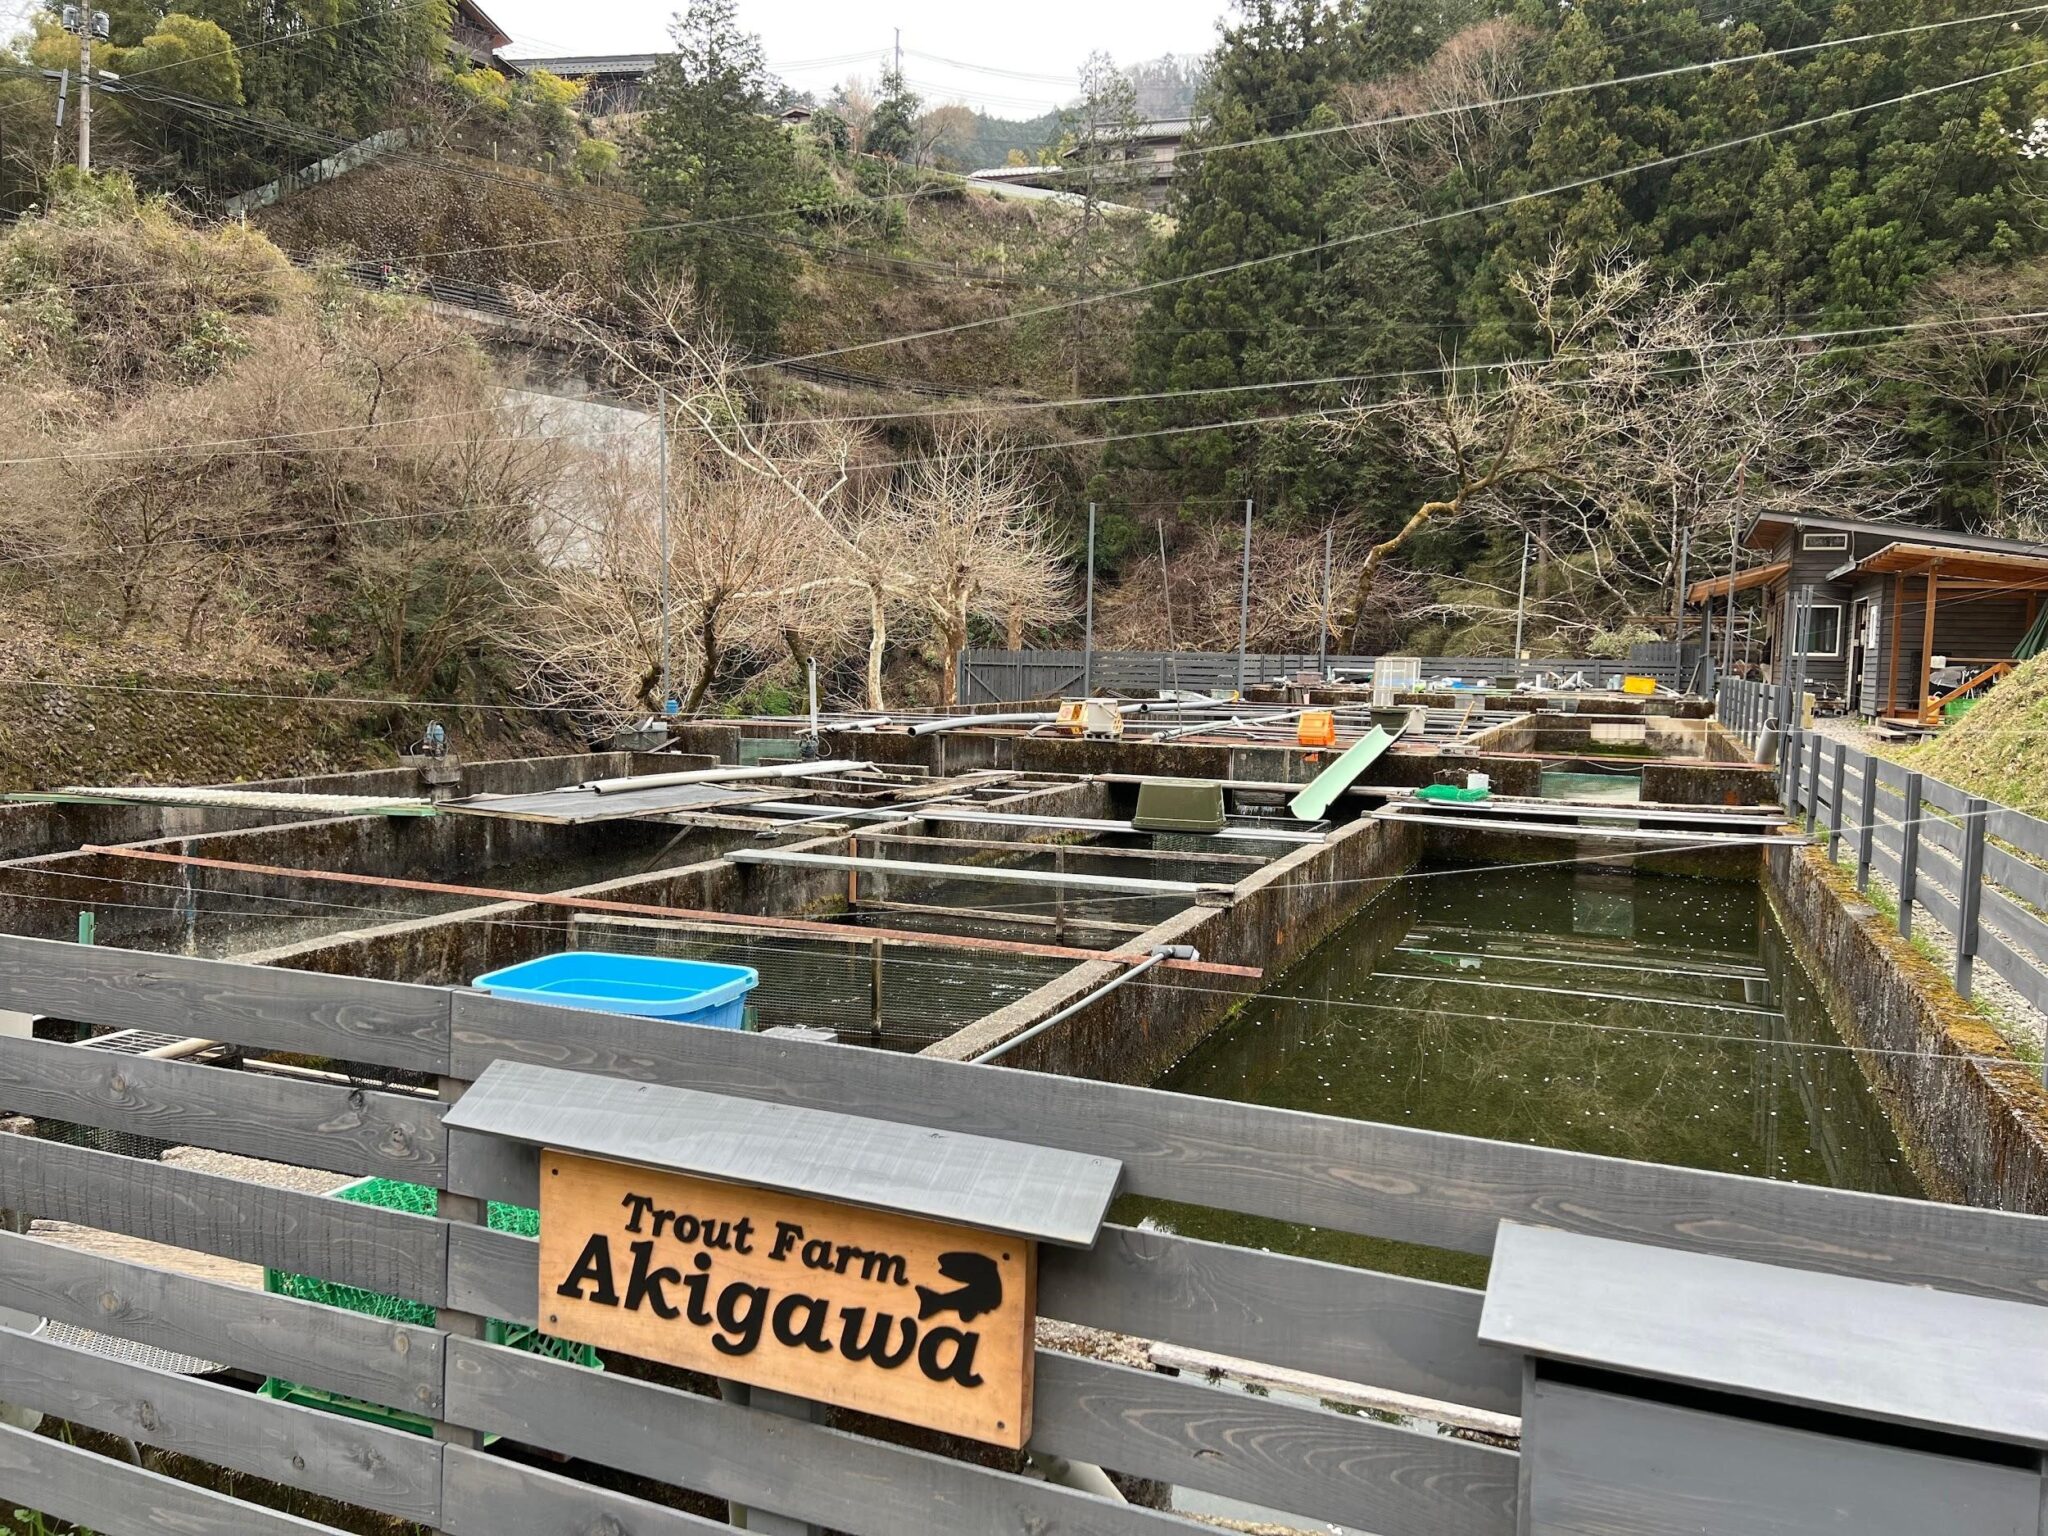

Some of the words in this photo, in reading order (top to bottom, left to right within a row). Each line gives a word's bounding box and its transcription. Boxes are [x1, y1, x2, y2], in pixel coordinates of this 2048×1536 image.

[622, 1192, 755, 1255] Trout
[767, 1220, 909, 1287] Farm
[556, 1233, 984, 1388] Akigawa
